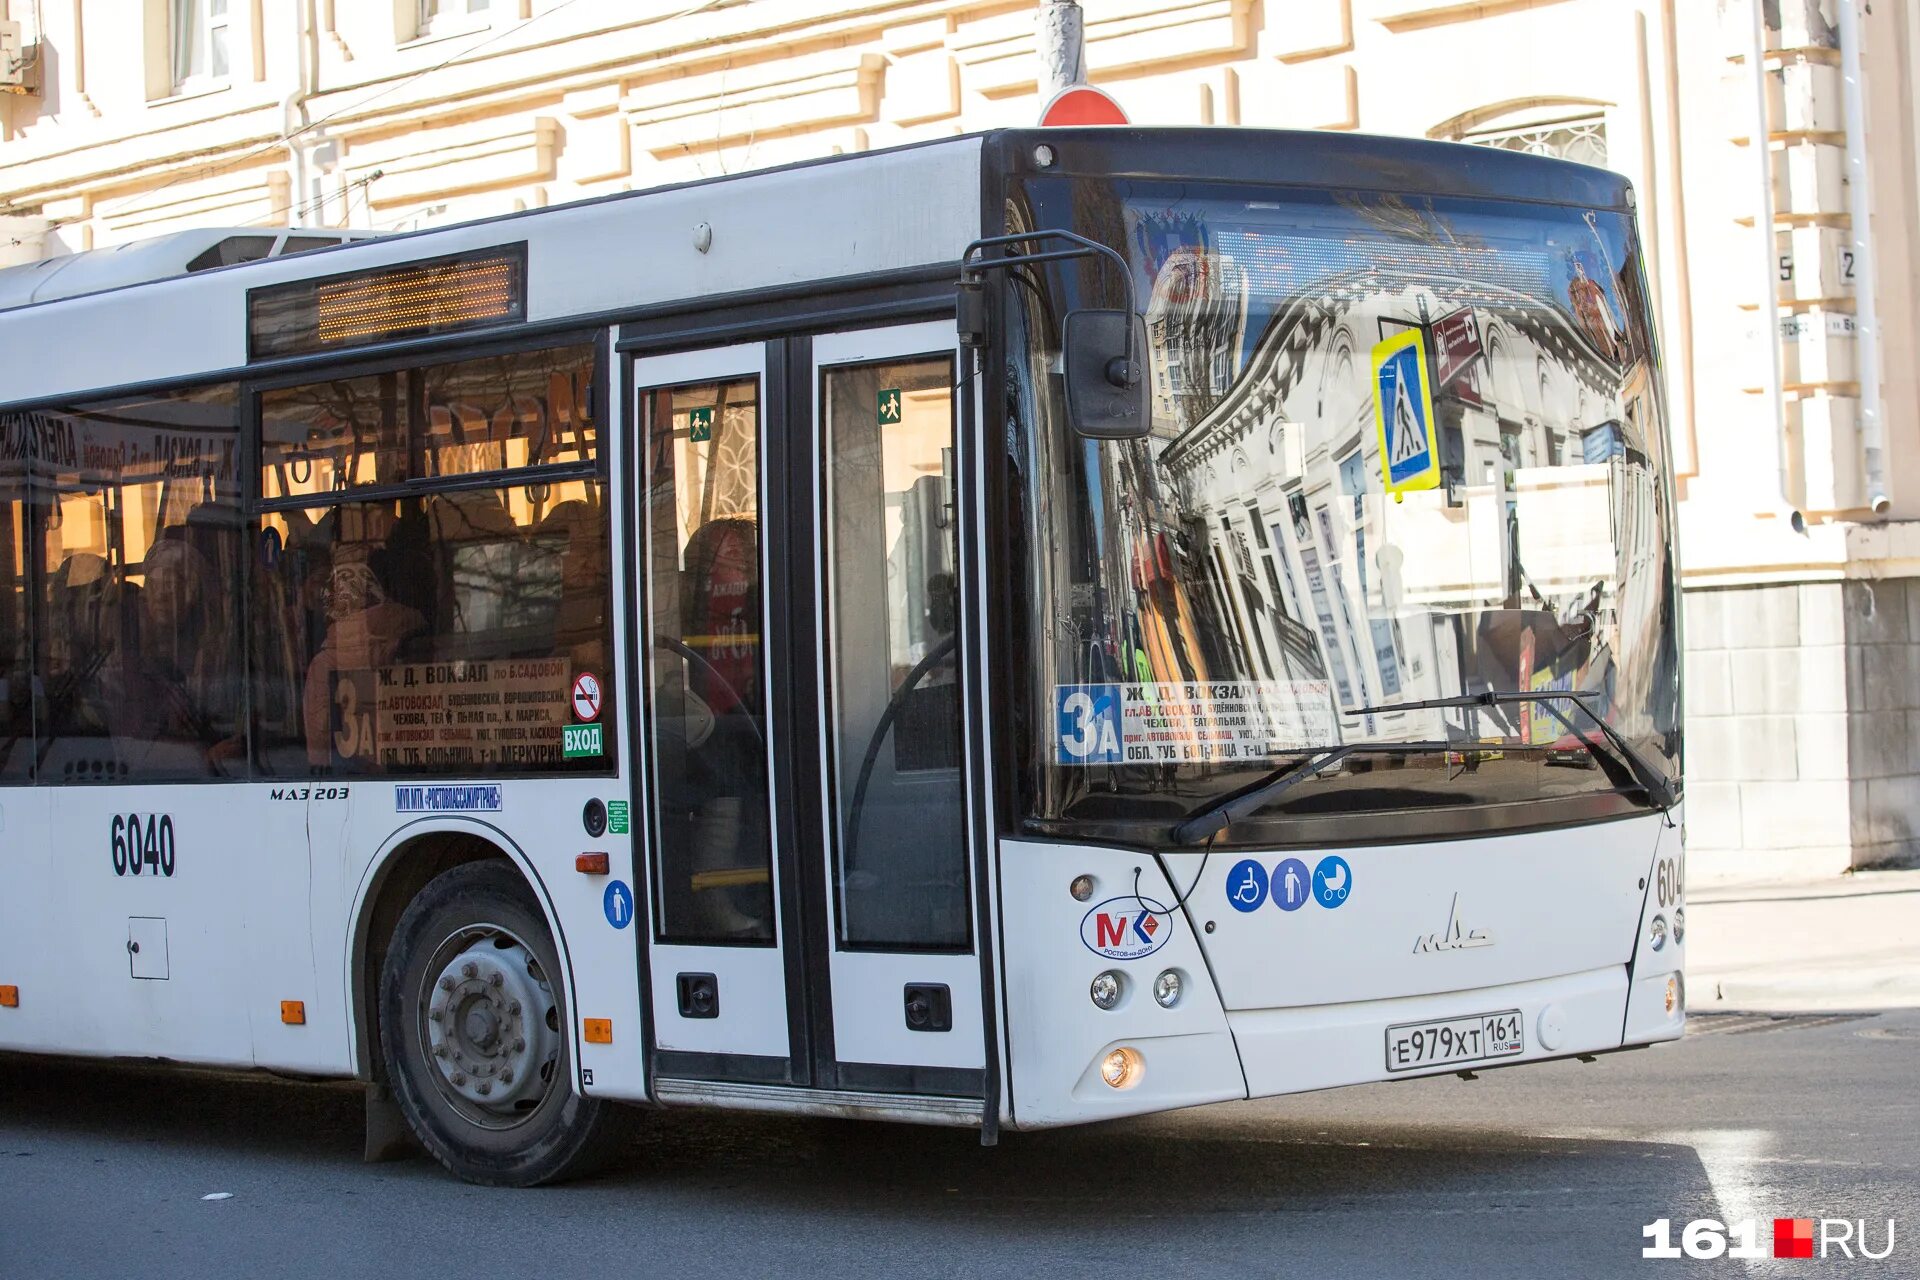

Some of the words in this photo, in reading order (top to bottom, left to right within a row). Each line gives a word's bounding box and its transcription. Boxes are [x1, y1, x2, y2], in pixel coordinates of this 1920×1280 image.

[1061, 692, 1120, 757] 3А
[564, 728, 601, 754] ВХОД
[1128, 746, 1153, 760] ОБЛ.
[270, 788, 310, 801] МАЗ
[315, 787, 349, 800] 203
[397, 787, 410, 810] МУП
[411, 787, 424, 810] МТК
[111, 813, 175, 877] 6040
[1397, 1026, 1481, 1064] Е979ХТ
[1486, 1016, 1518, 1042] 161
[1493, 1041, 1510, 1052] RUS
